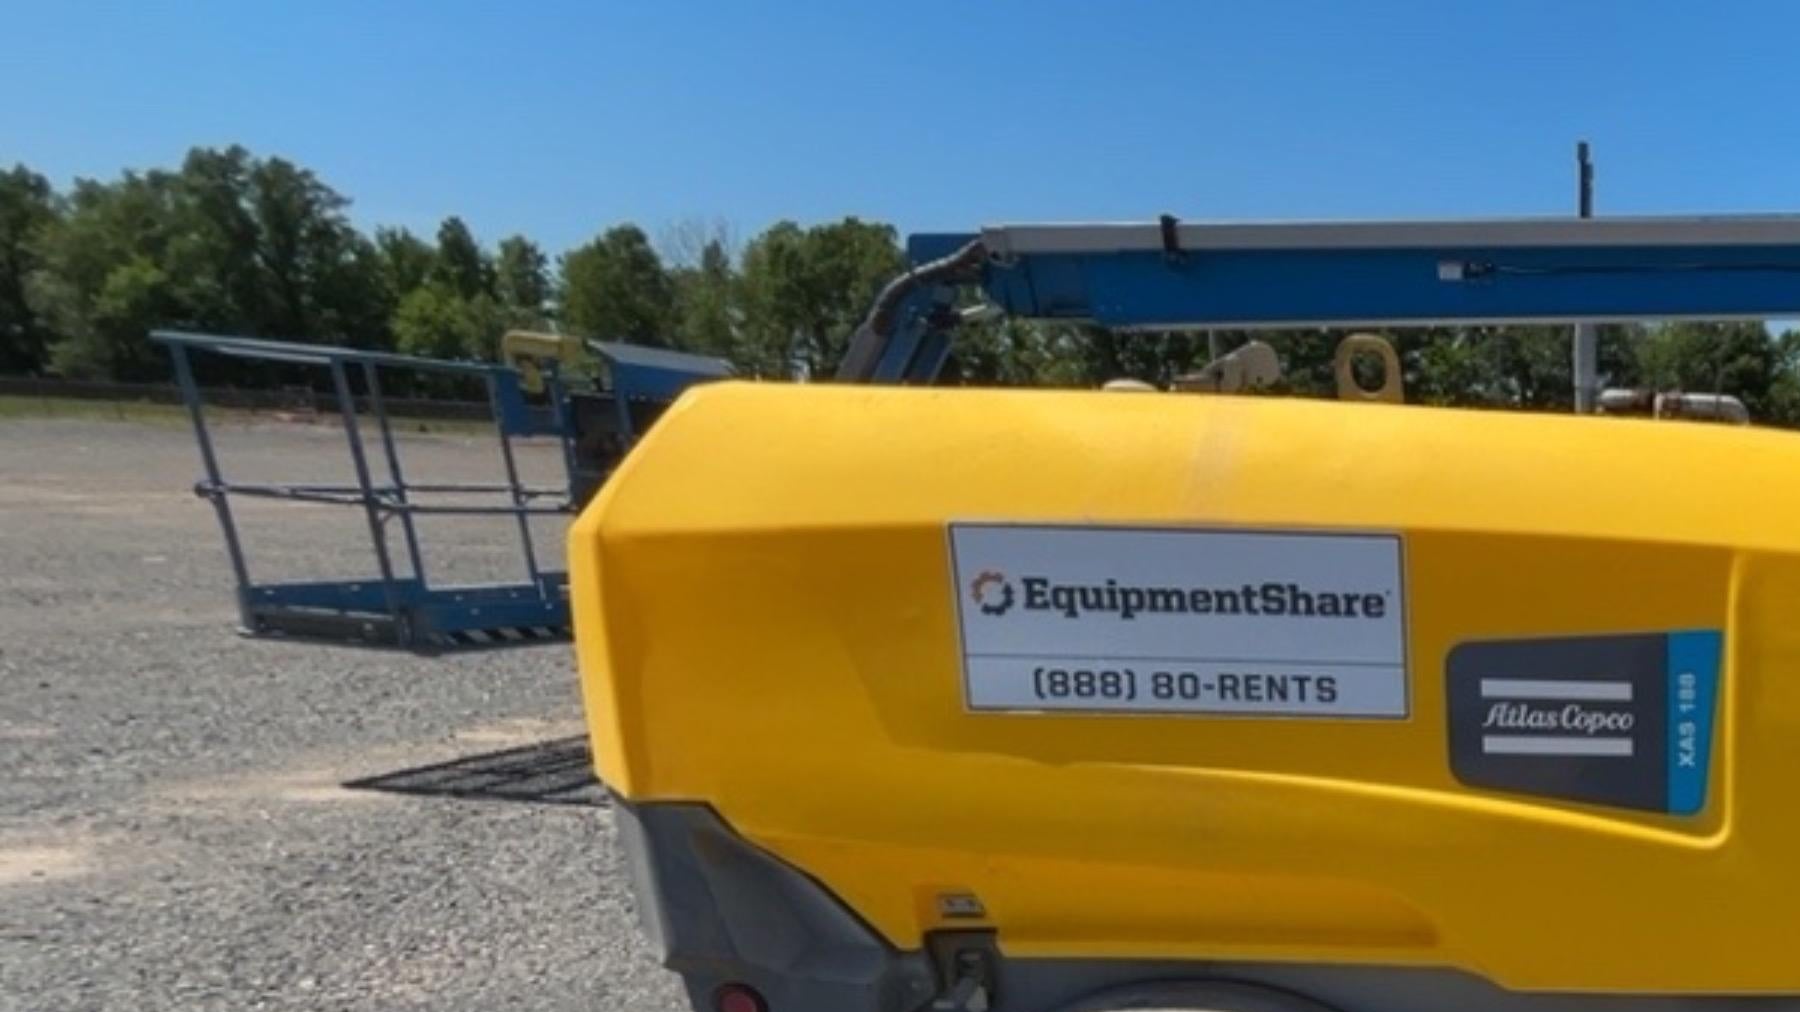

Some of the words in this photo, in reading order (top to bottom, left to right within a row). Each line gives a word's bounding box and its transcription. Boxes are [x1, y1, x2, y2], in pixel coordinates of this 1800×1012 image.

[1020, 577, 1386, 618] EquipmentShare
[1033, 668, 1136, 699] (888)
[1151, 673, 1338, 702] 80-RENTS
[1677, 721, 1697, 767] XAS
